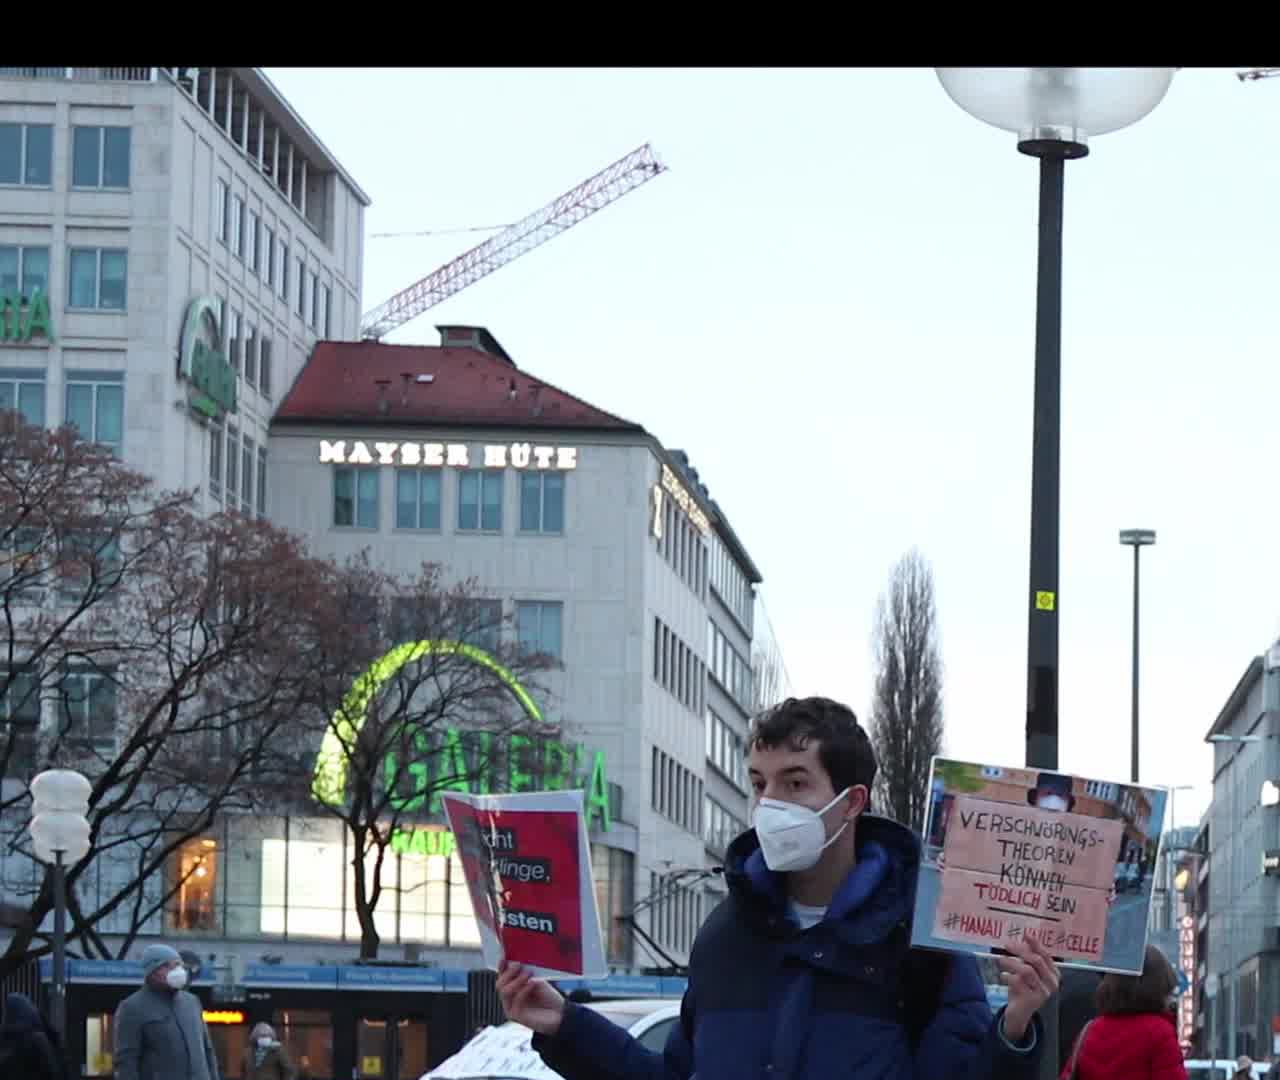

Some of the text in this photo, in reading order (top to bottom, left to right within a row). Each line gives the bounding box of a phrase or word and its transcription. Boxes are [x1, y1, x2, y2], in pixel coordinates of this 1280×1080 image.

[320, 440, 577, 469] MAYSER HÜTE
[1046, 894, 1076, 915] SEIN
